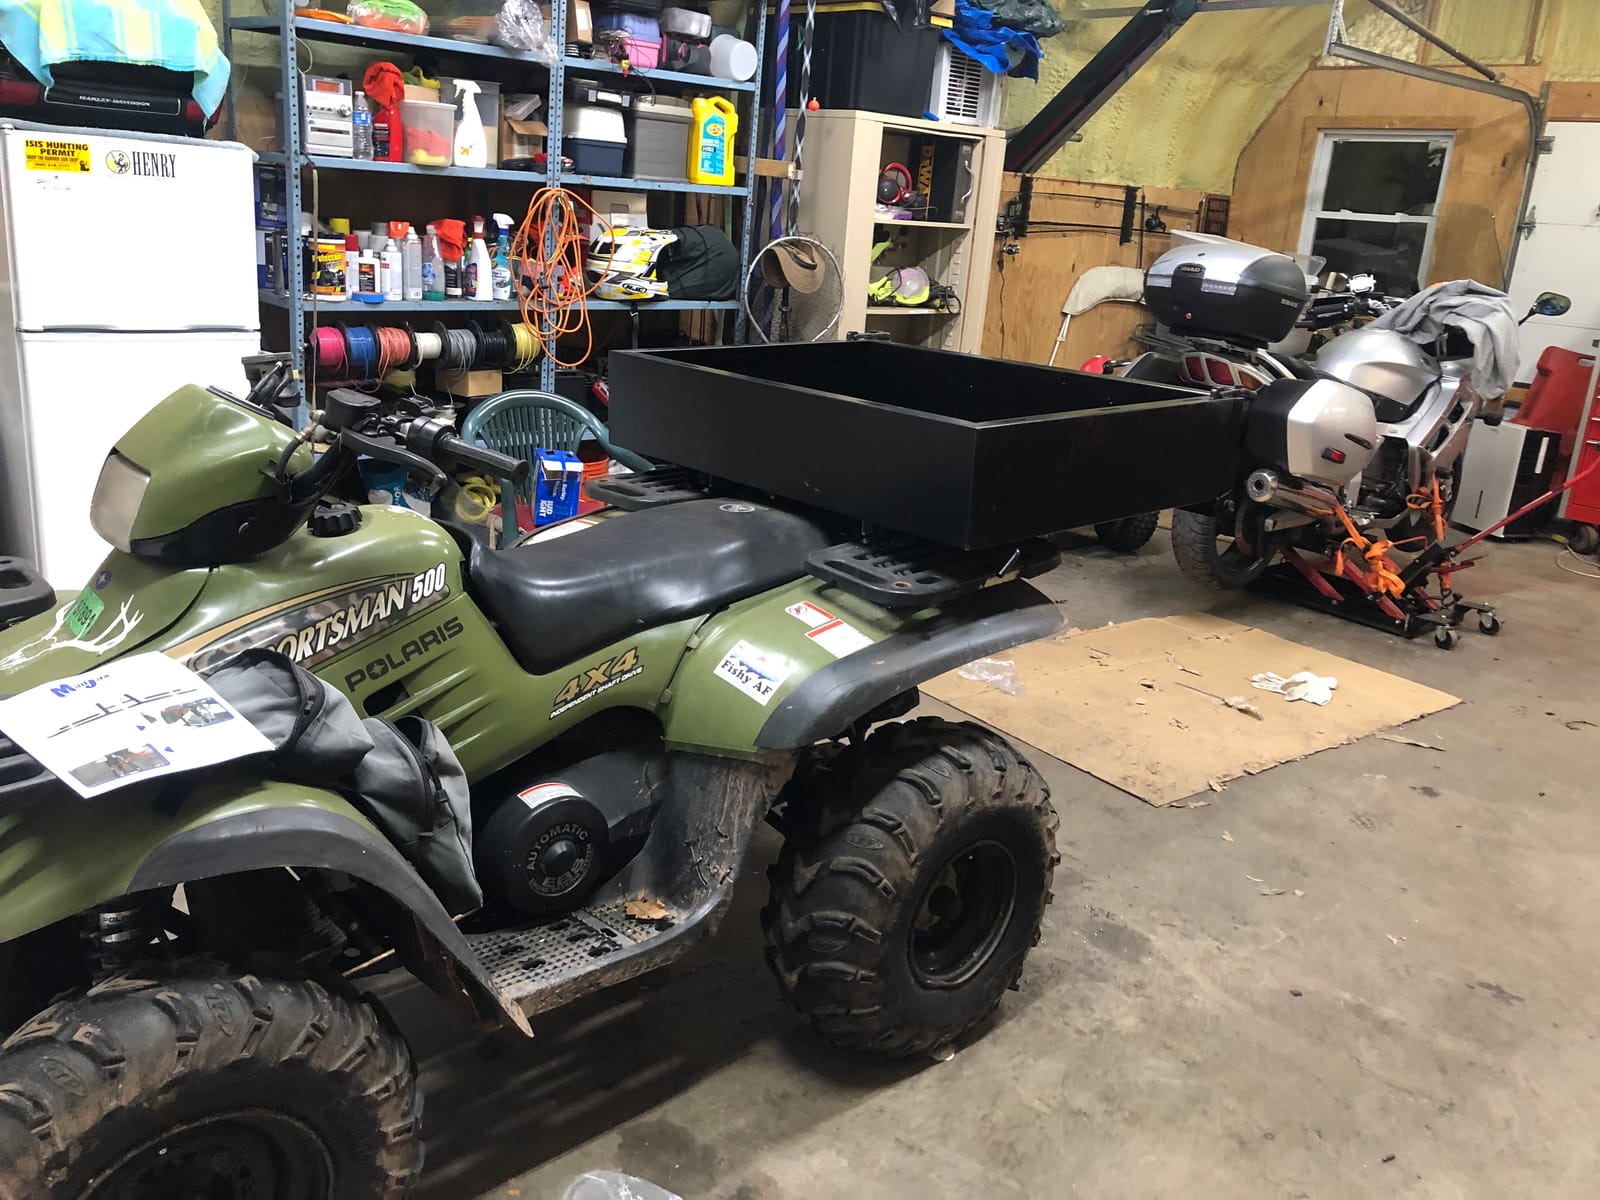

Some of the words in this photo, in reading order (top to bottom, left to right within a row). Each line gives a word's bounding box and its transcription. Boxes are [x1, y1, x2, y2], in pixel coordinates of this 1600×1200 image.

[25, 139, 43, 148] ISIS
[46, 141, 88, 151] HUNTING
[40, 148, 75, 157] PERMIT
[132, 151, 176, 178] HENRY
[411, 562, 447, 604] 500
[344, 616, 464, 692] POLARIS
[721, 660, 752, 684] Fishy
[752, 681, 773, 696] AF
[527, 823, 589, 870] AUTOMATIC
